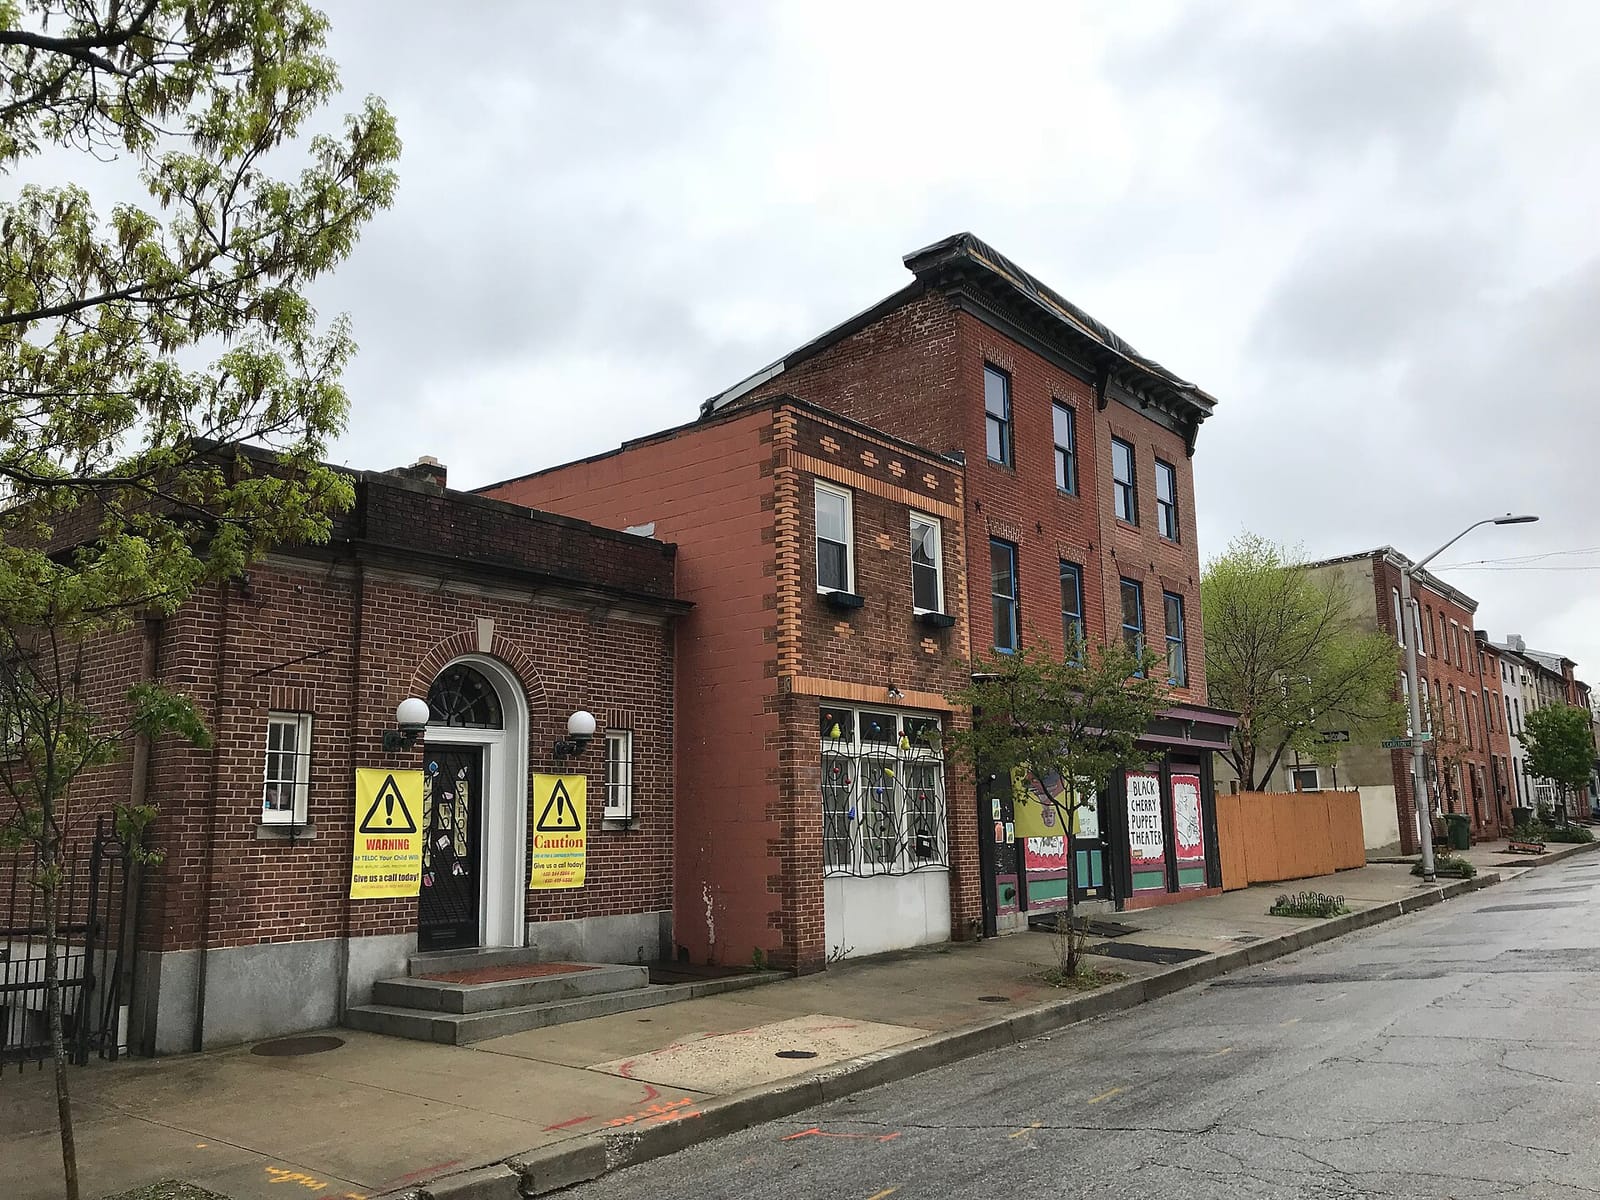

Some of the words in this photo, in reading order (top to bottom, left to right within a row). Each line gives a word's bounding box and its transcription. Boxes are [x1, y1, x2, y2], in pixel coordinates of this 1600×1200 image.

[1133, 781, 1155, 796] BLACK
[1131, 799, 1157, 812] CHERRY
[457, 782, 466, 856] SCHOOL
[1132, 815, 1158, 829] PUPPET
[366, 838, 410, 851] WARNING
[534, 834, 584, 848] Caution
[1131, 830, 1162, 845] THEATER
[568, 861, 584, 869] today!
[353, 874, 368, 883] Give
[384, 873, 398, 882] call
[398, 872, 420, 882] today!
